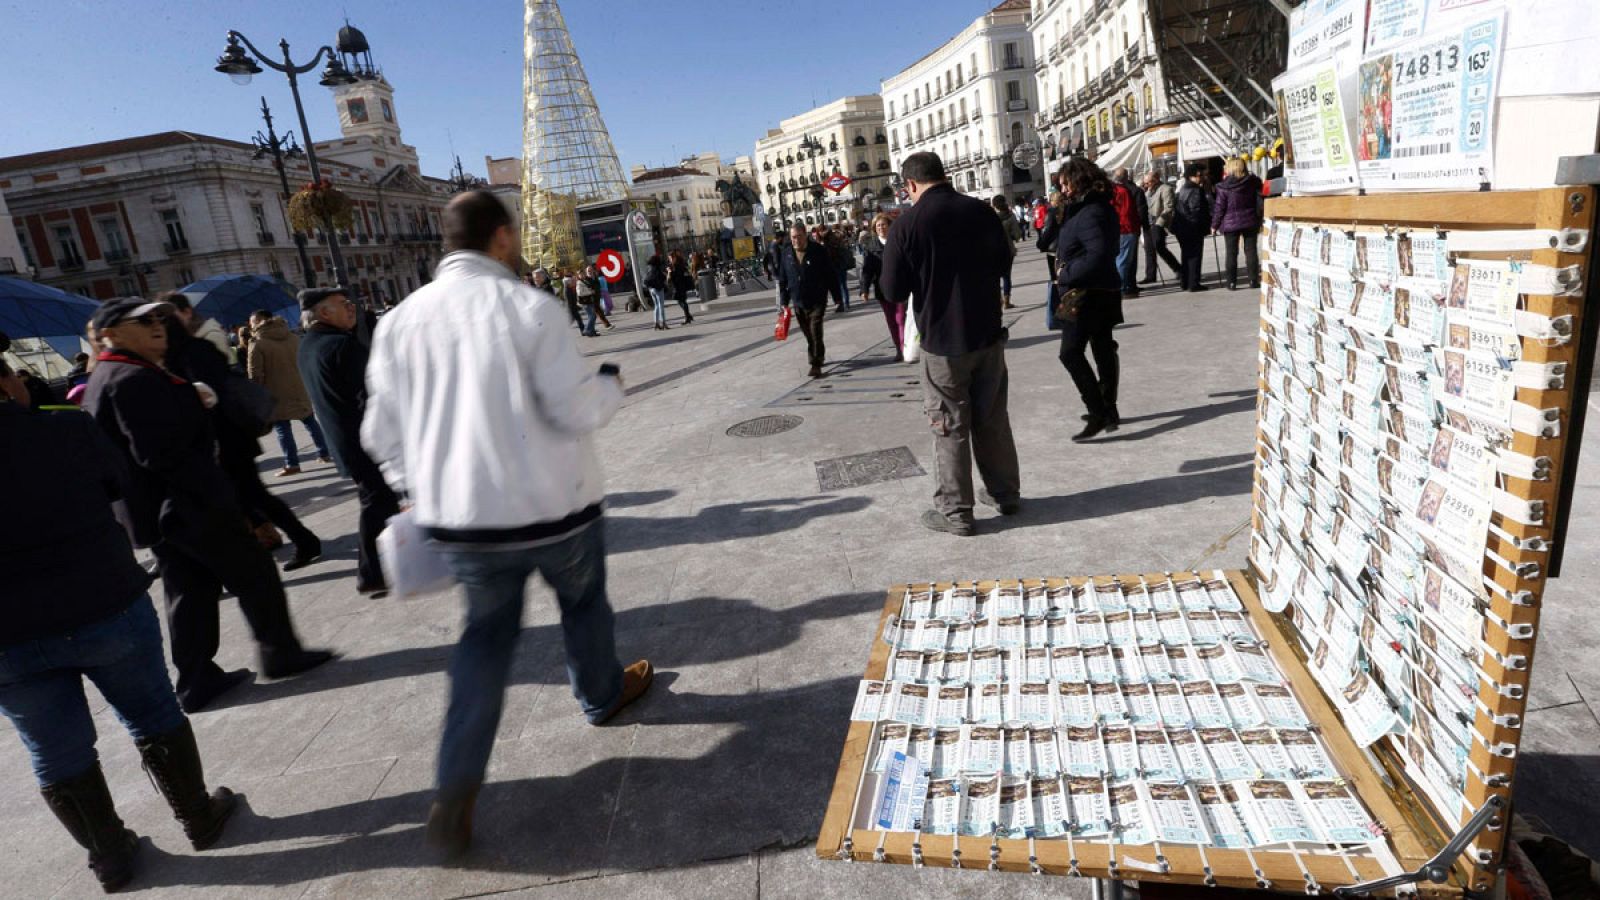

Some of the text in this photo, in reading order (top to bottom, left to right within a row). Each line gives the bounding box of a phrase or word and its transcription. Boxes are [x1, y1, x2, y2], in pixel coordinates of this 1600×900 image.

[1395, 44, 1459, 82] 74813
[1421, 81, 1456, 95] NACIONAL
[1469, 121, 1481, 136] 20
[1471, 268, 1501, 280] 33611
[1471, 331, 1504, 345] 33611
[1465, 360, 1498, 376] 61255
[1454, 437, 1482, 458] 92950
[1444, 494, 1474, 517] 92950
